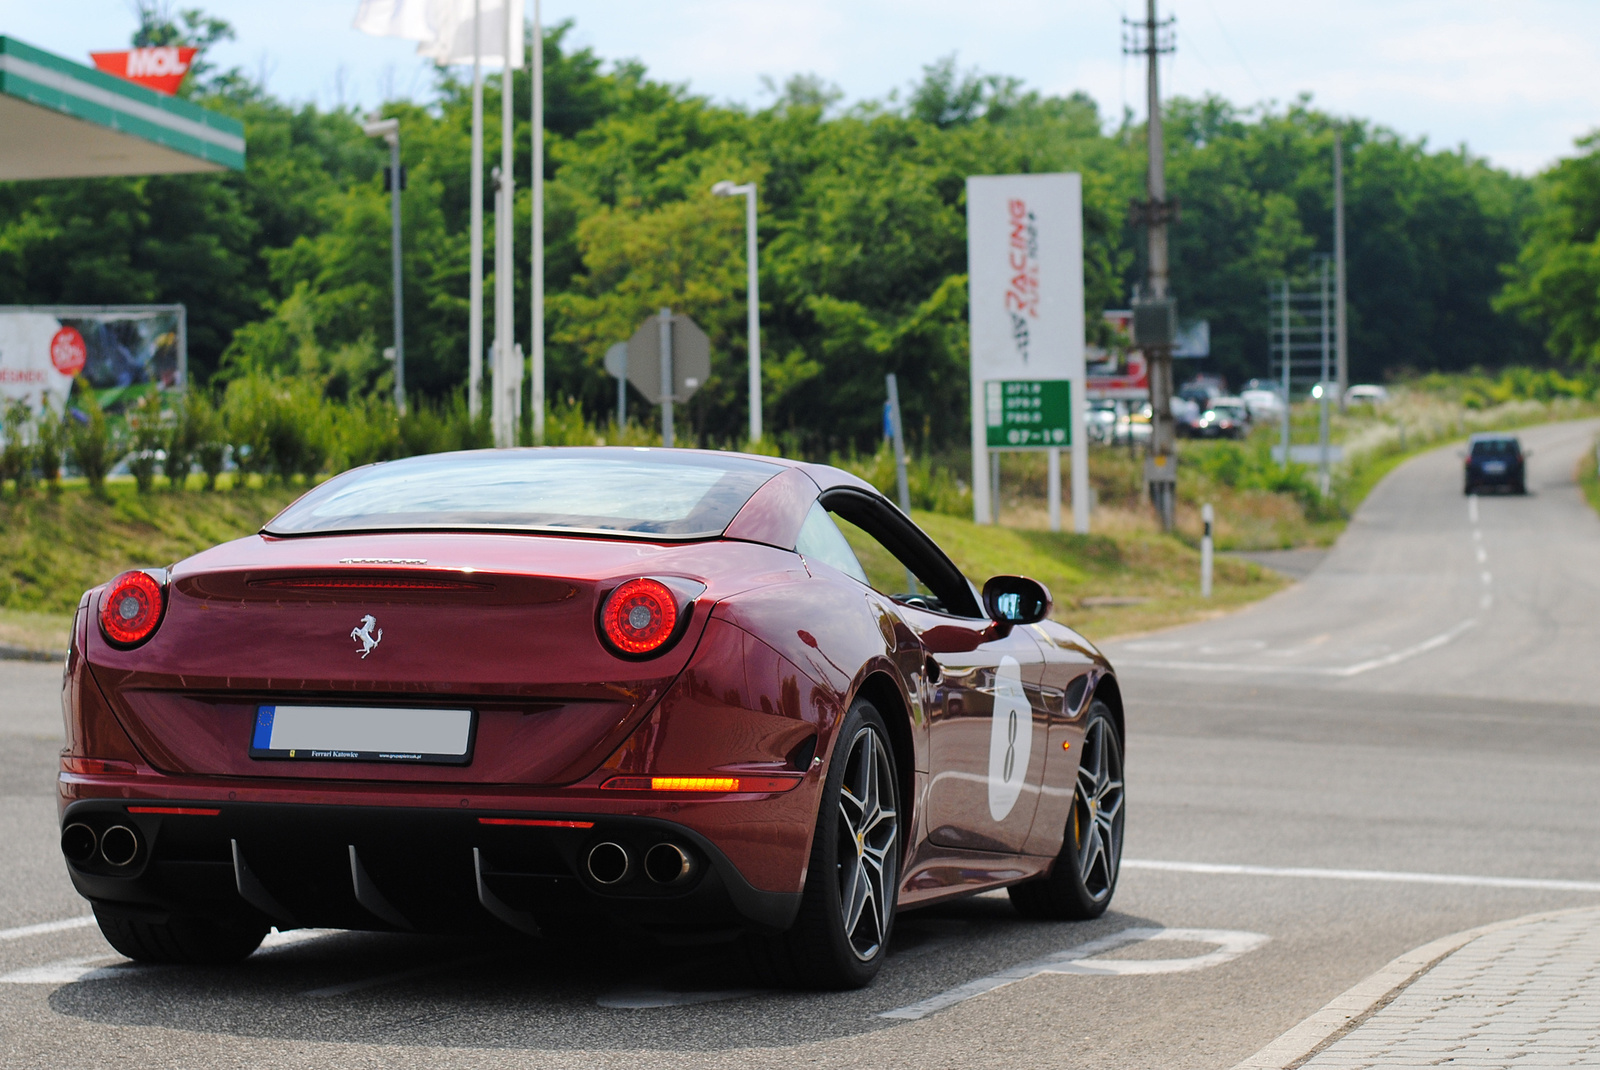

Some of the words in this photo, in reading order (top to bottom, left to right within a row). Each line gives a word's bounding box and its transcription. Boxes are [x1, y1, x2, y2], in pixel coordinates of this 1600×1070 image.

[126, 48, 188, 77] MOL
[1005, 198, 1026, 311] RACING
[1003, 709, 1018, 784] 8
